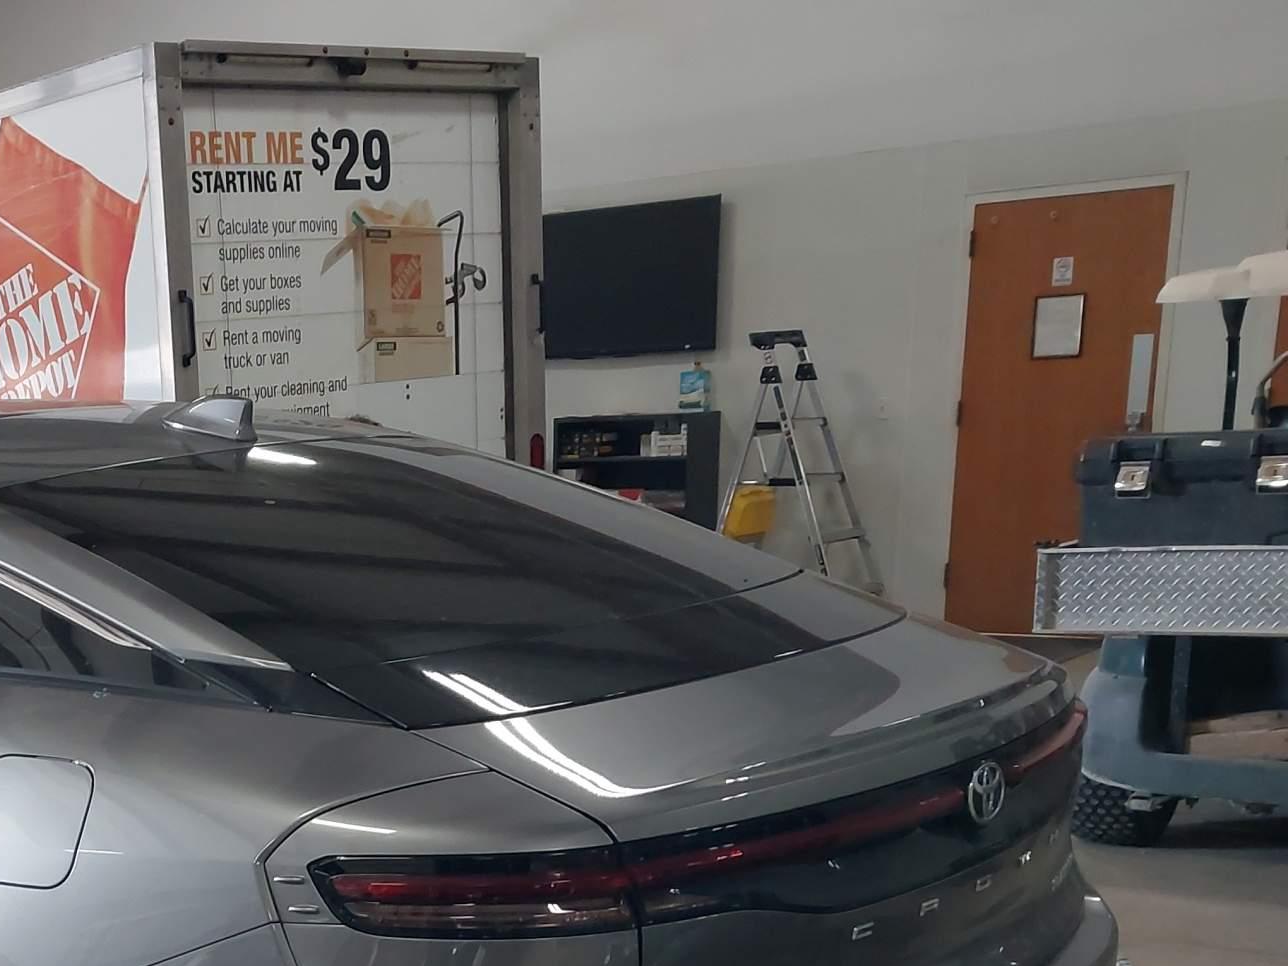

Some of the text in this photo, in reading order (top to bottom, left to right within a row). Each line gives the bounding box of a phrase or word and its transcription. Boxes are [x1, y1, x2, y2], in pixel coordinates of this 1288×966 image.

[189, 131, 304, 165] RENT ME
[311, 127, 391, 191] $29
[191, 170, 302, 194] STARTING AT
[217, 216, 338, 237] Calculate your moving
[218, 240, 301, 264] supplies online
[220, 273, 302, 295] Get your boxes
[221, 295, 291, 315] and supplies
[223, 326, 302, 347] Rent a moving
[224, 351, 289, 369] truck or van
[0, 349, 75, 400] POT
[225, 375, 348, 402] Rent your cleaning and
